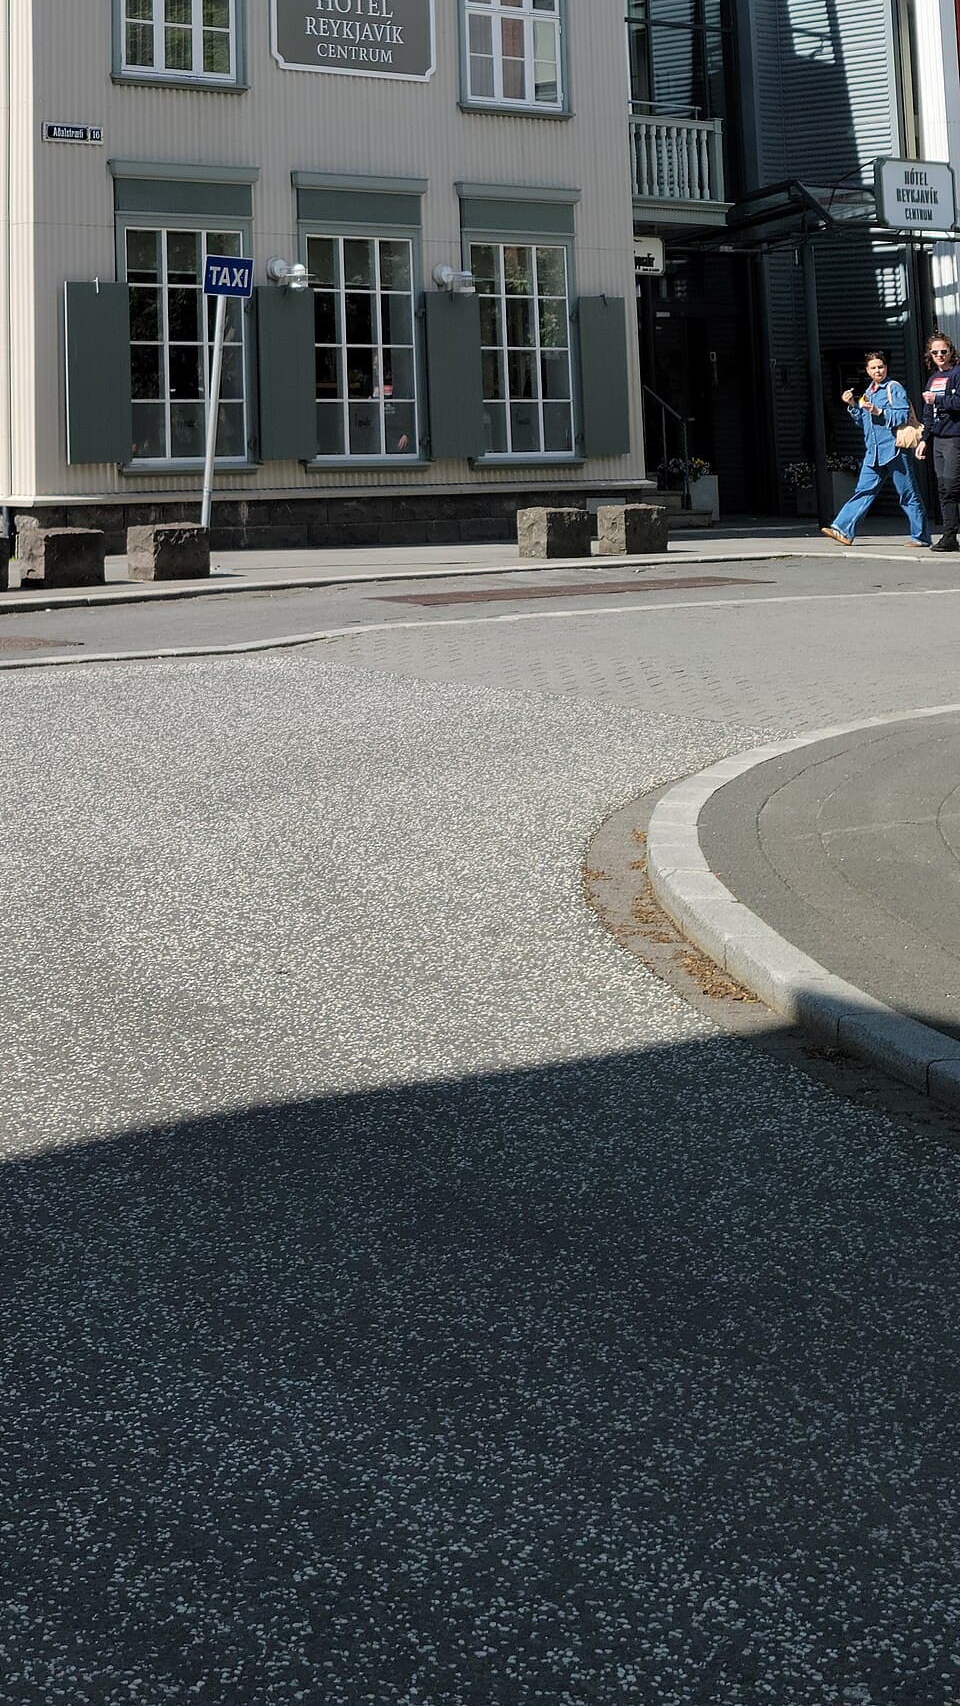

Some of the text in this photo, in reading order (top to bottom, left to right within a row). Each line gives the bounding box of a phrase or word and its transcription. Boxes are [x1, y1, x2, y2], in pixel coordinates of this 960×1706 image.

[305, 16, 405, 45] REYKJAVÍK
[317, 43, 393, 63] CENTRUM
[904, 167, 929, 186] HÓTEL
[896, 186, 939, 205] REYKJAVÍK
[904, 207, 933, 221] CENTRUM
[209, 265, 249, 288] TAXI
